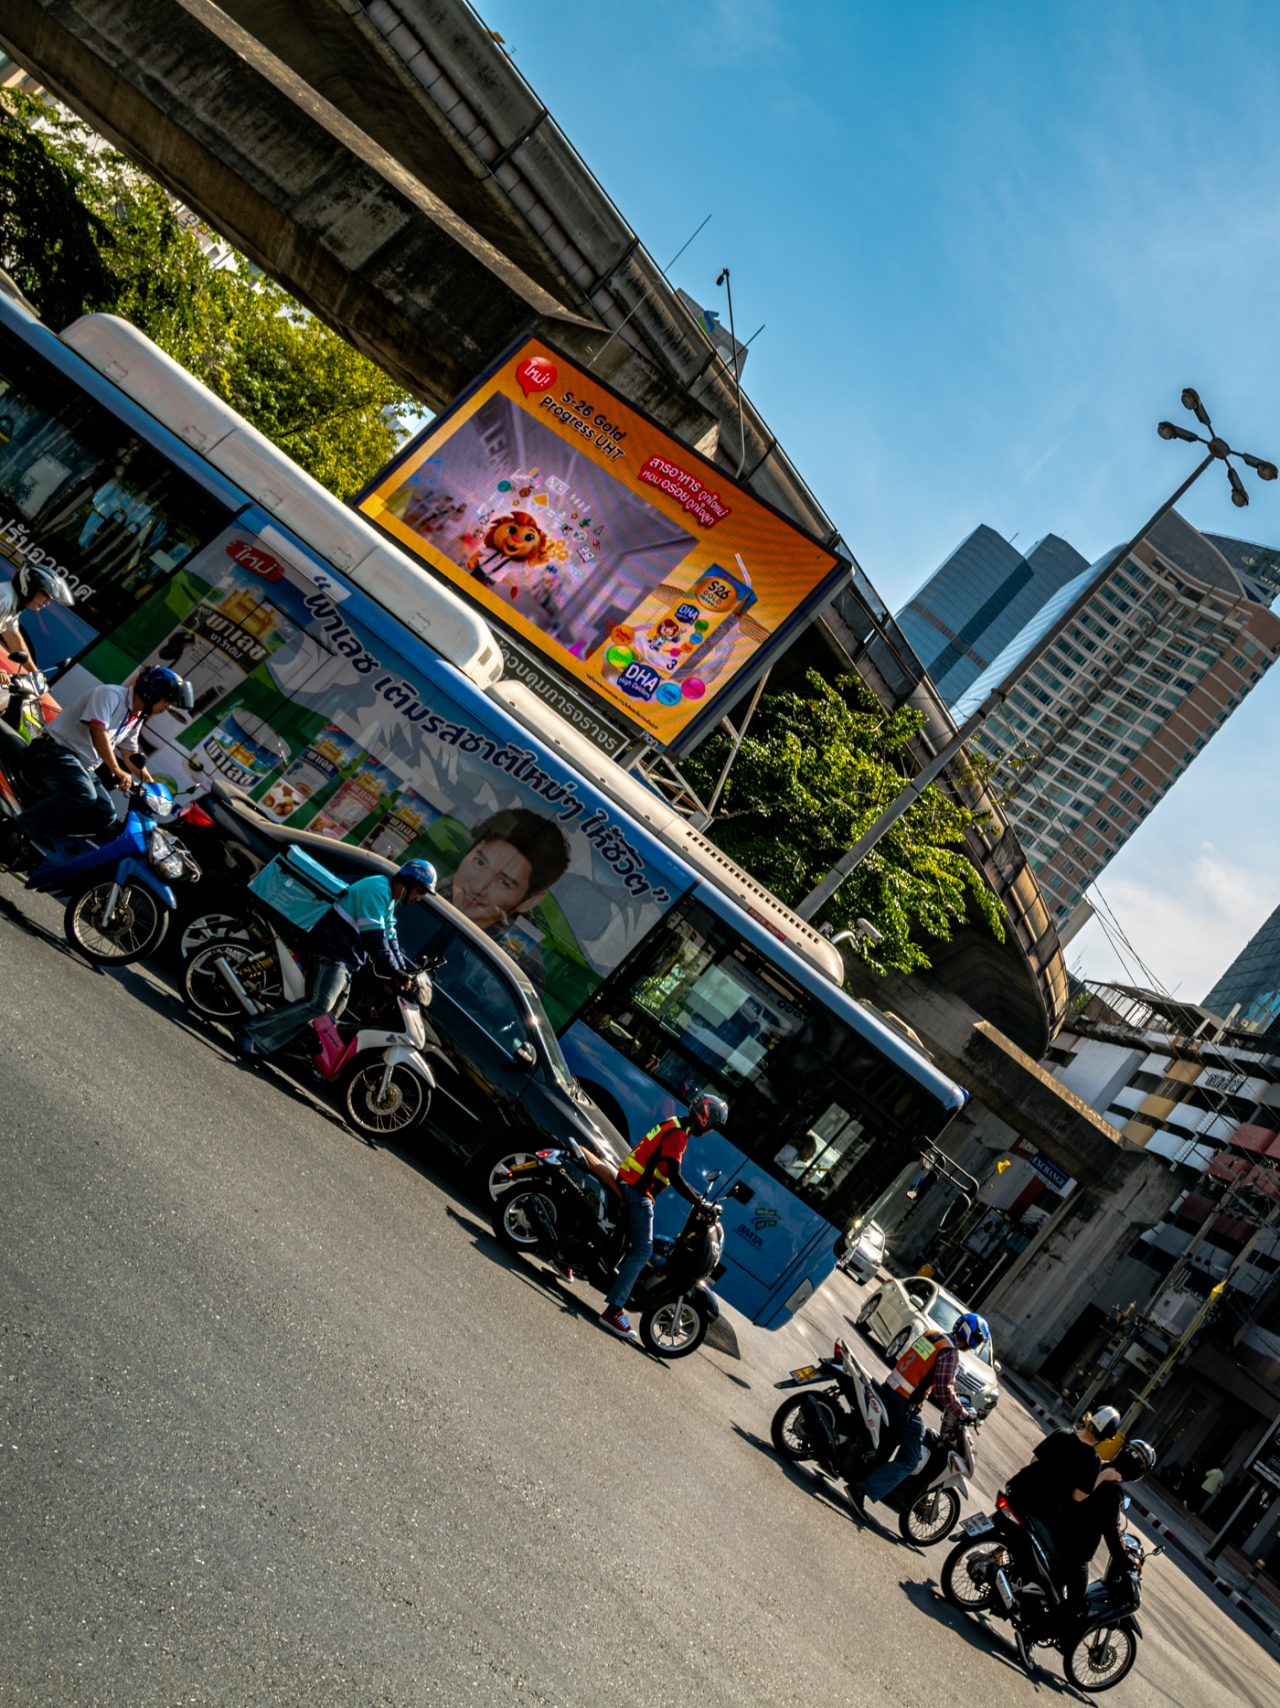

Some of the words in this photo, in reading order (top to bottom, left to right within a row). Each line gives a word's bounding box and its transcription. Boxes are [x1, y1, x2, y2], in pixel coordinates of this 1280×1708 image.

[523, 360, 550, 387] ใหม่!
[540, 396, 595, 440] Progress
[593, 433, 625, 460] UHT
[561, 391, 594, 417] S-26
[593, 413, 626, 442] Gold
[649, 456, 702, 493] สารอาหาร
[661, 480, 688, 503] อร่อย
[233, 543, 278, 576] ใหม่
[624, 663, 658, 692] DHA
[666, 659, 678, 670] 3
[1031, 1156, 1066, 1187] EXCHANGE
[736, 1223, 763, 1247] BMTA
